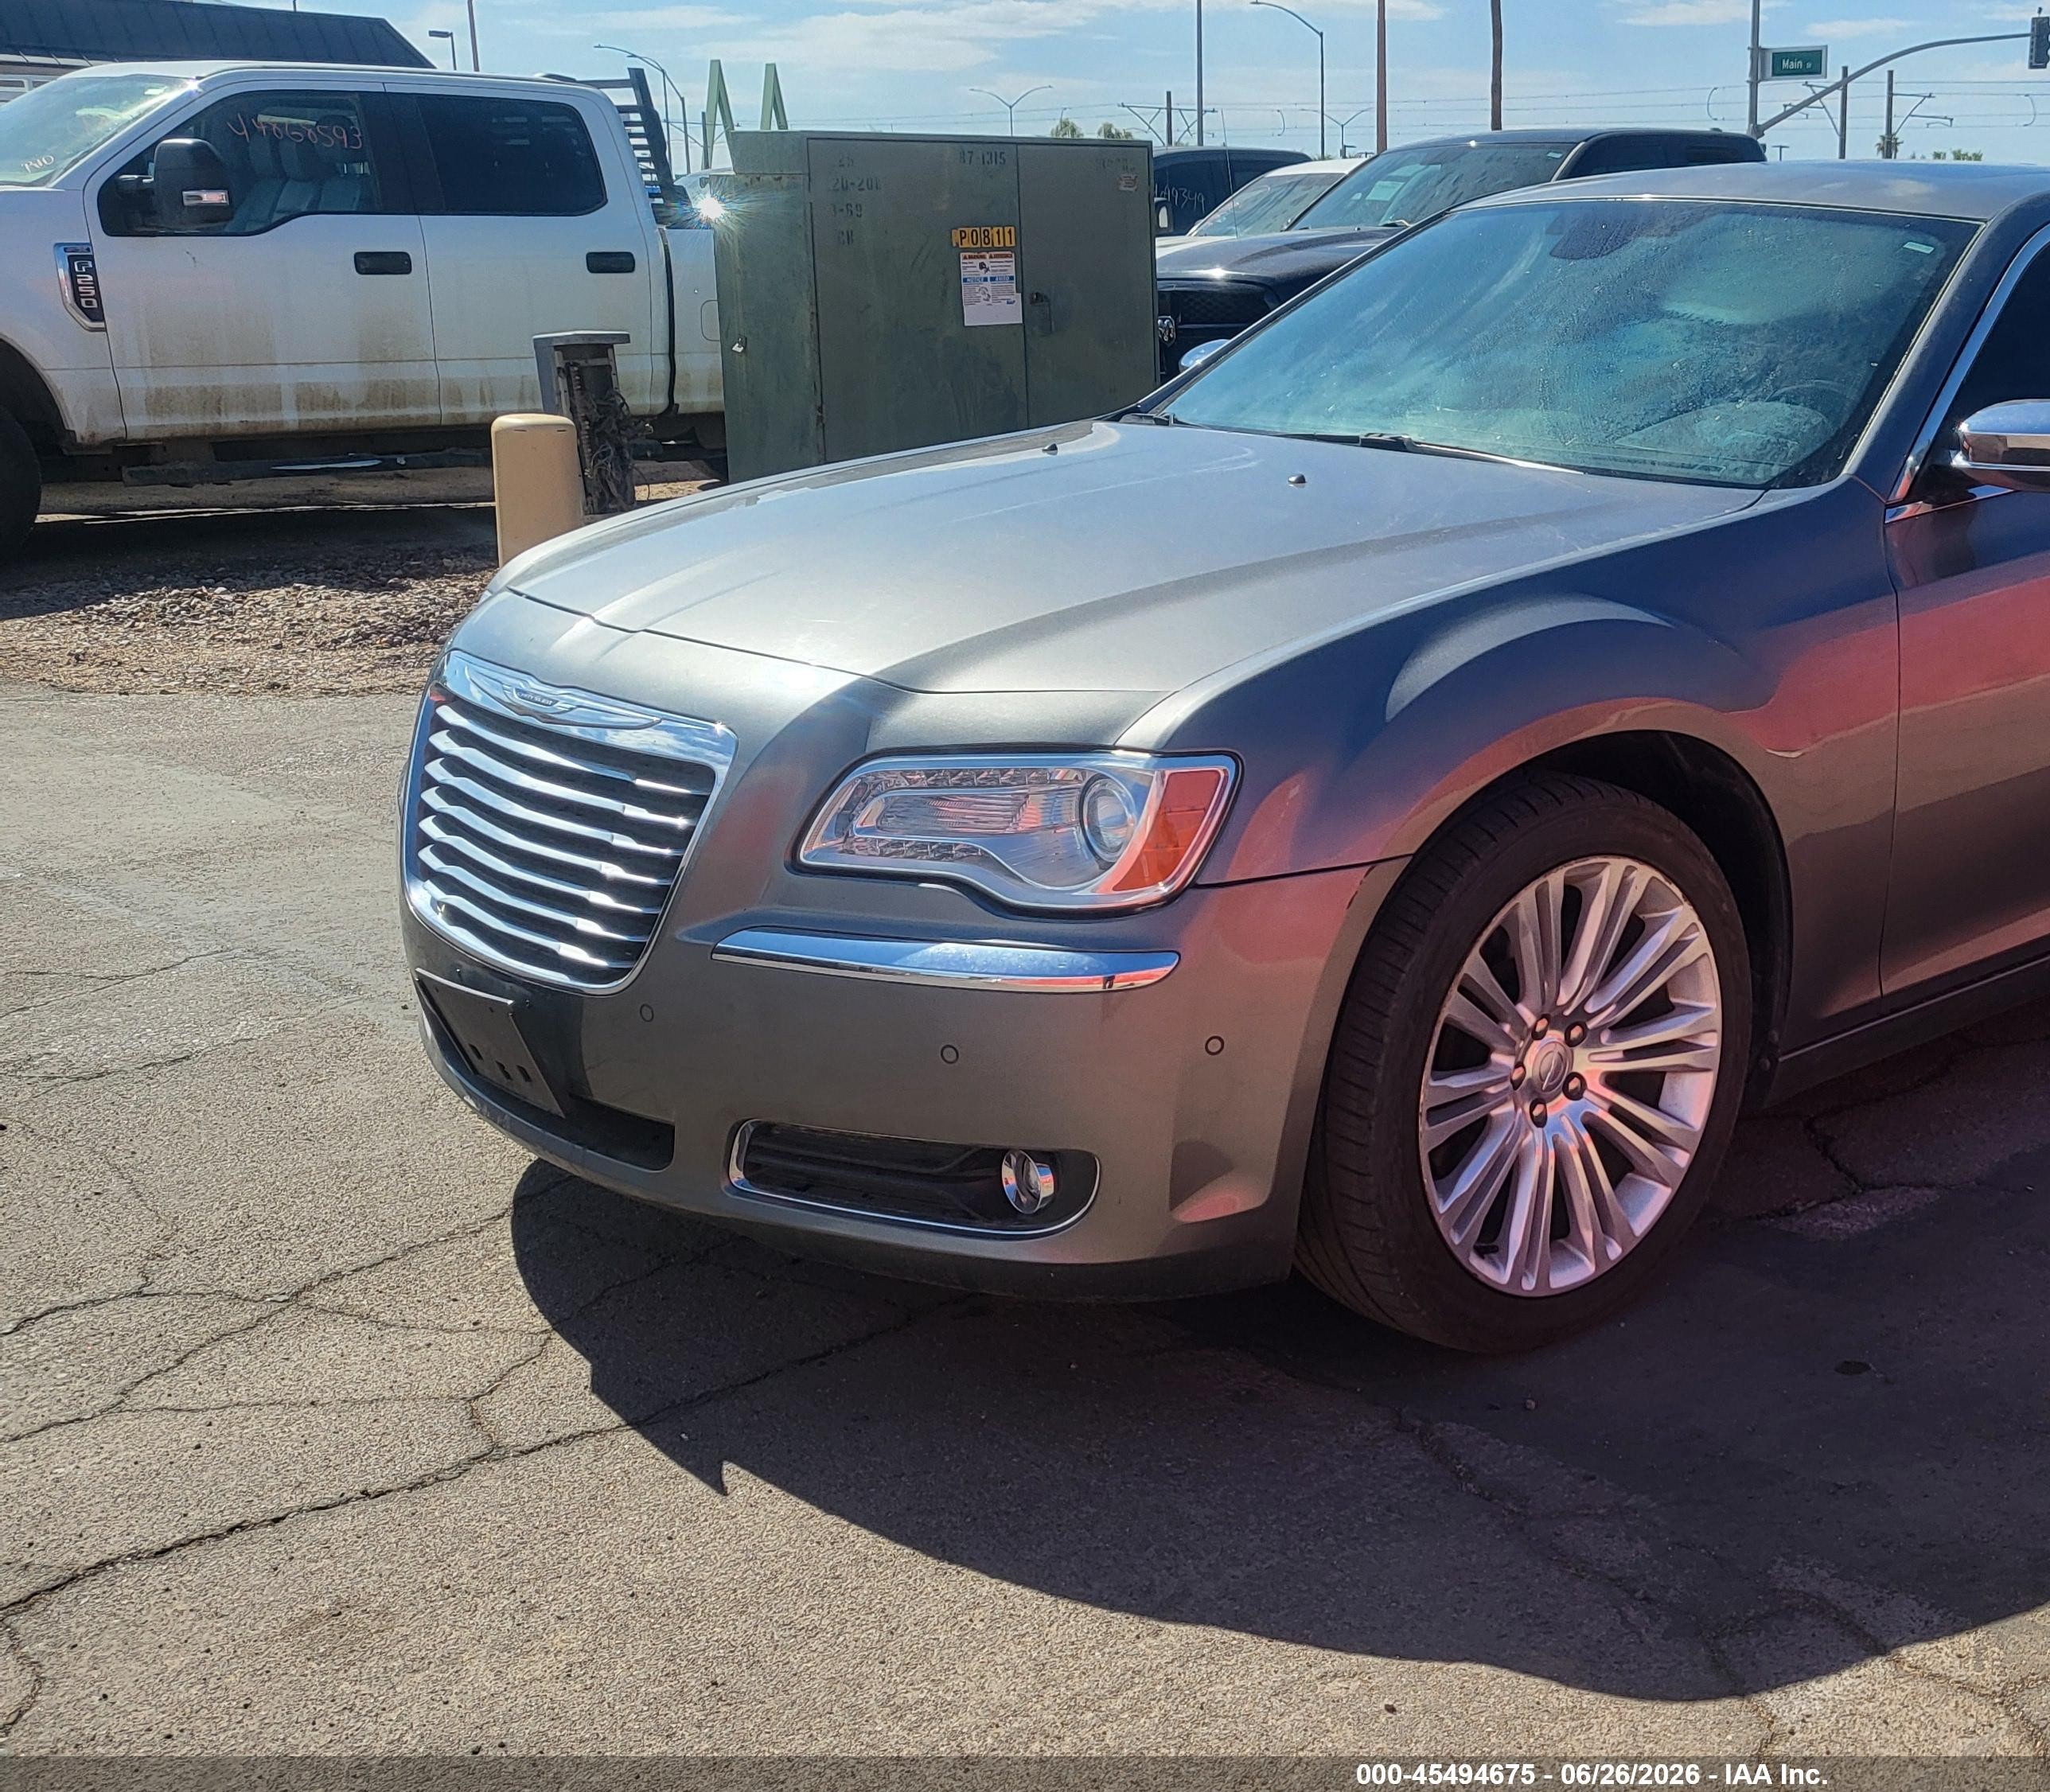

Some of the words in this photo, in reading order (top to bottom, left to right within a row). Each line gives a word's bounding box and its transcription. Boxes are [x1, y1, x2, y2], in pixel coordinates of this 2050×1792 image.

[1783, 58, 1803, 69] Main
[959, 228, 1013, 246] P0811
[74, 260, 99, 309] F250
